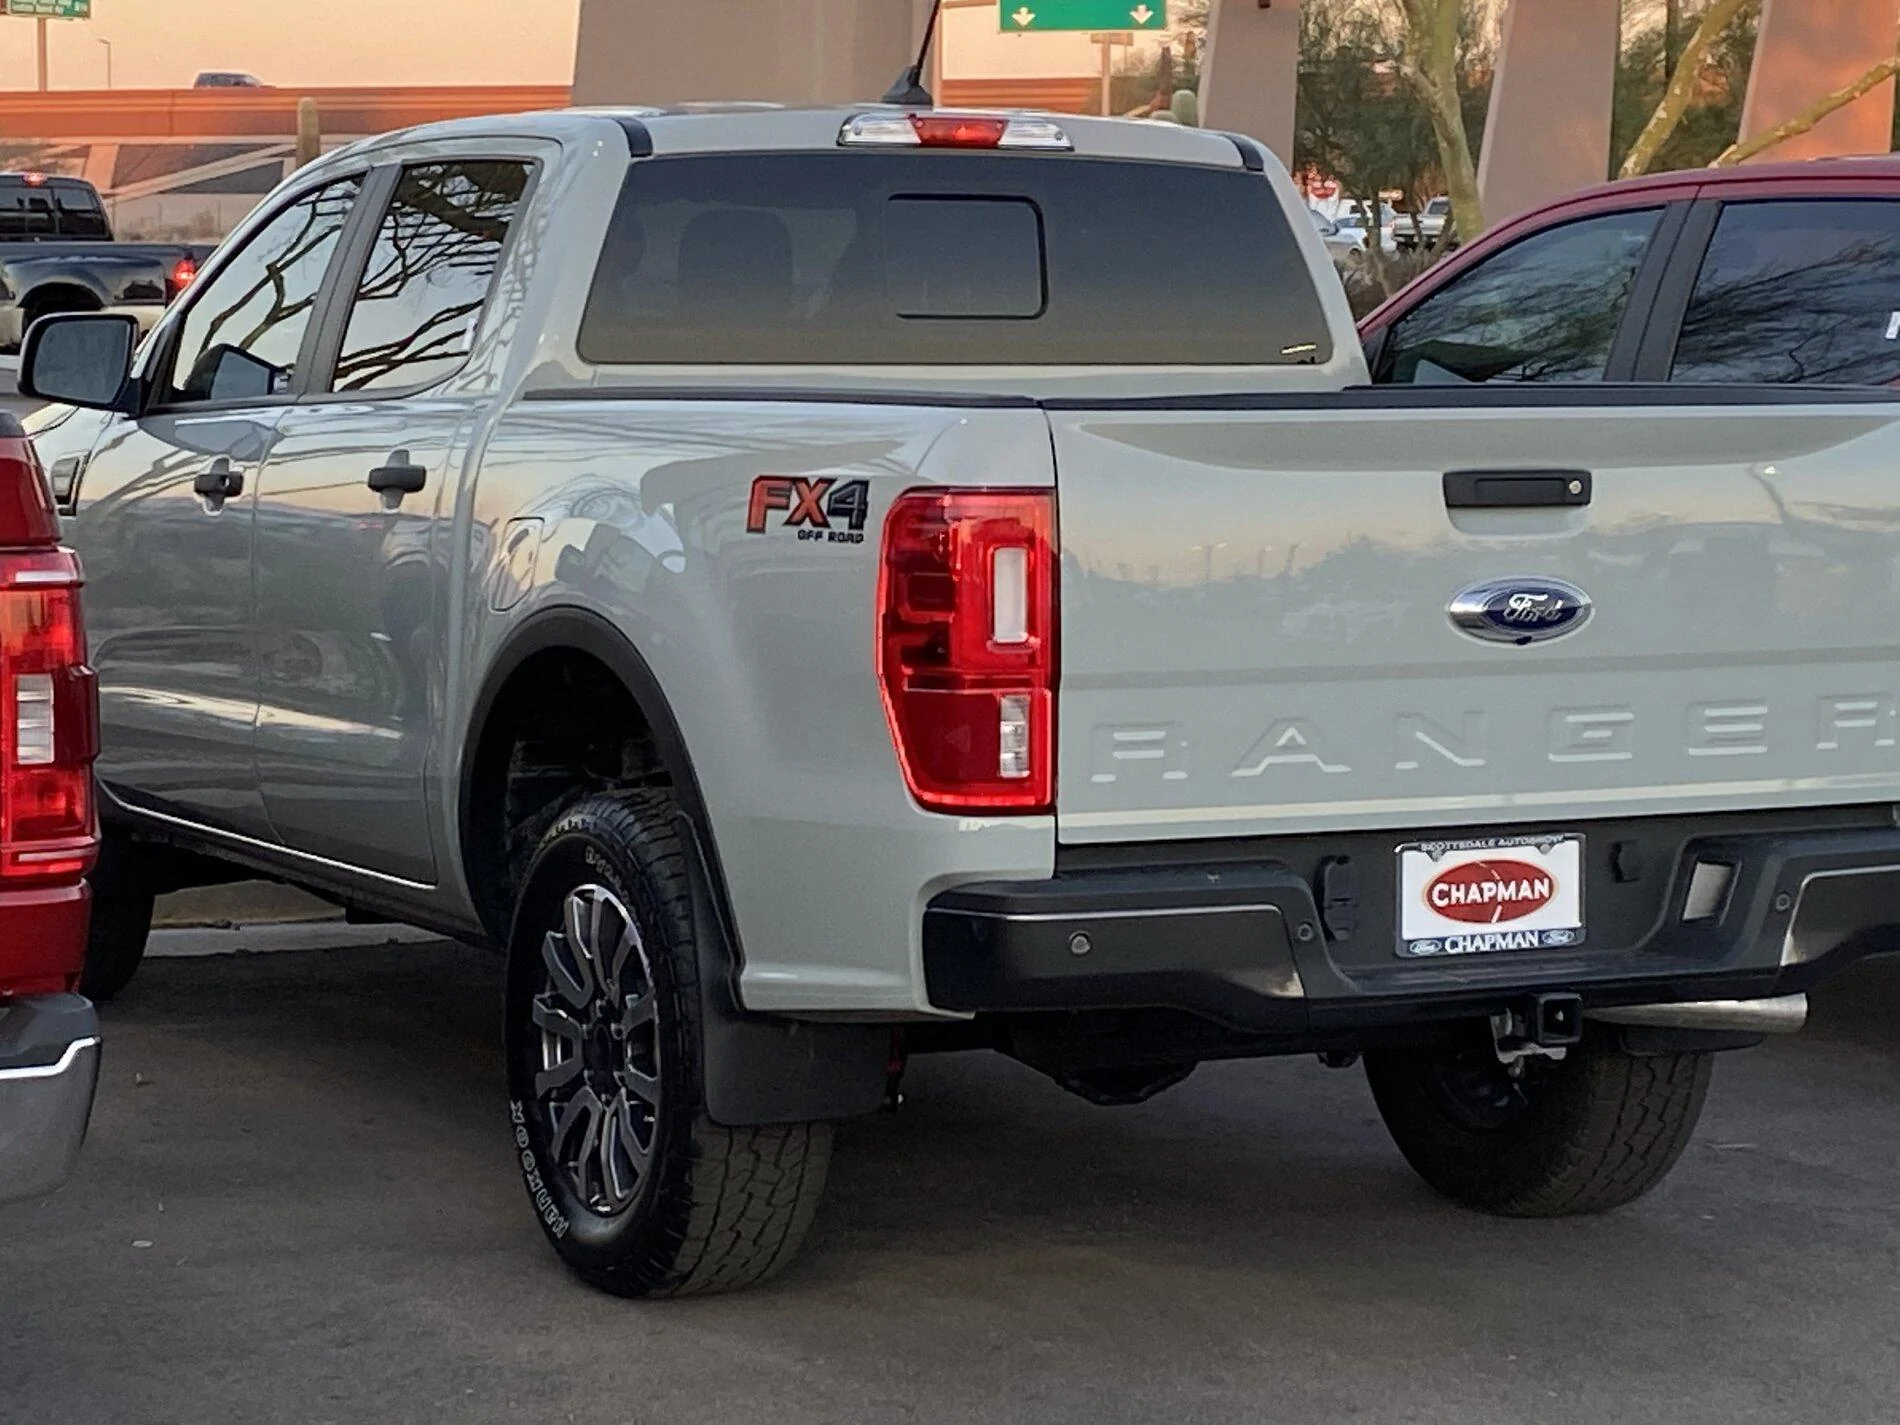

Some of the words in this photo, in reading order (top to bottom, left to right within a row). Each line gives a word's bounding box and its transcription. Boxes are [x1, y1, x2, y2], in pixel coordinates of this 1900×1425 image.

[746, 475, 870, 534] FX4
[797, 529, 823, 541] OFF
[828, 532, 865, 544] ROAD
[1503, 593, 1564, 622] Ford
[1089, 693, 1900, 783] RANGER
[1431, 877, 1551, 908] CHAPMAN
[1444, 930, 1540, 954] CHAPMAN
